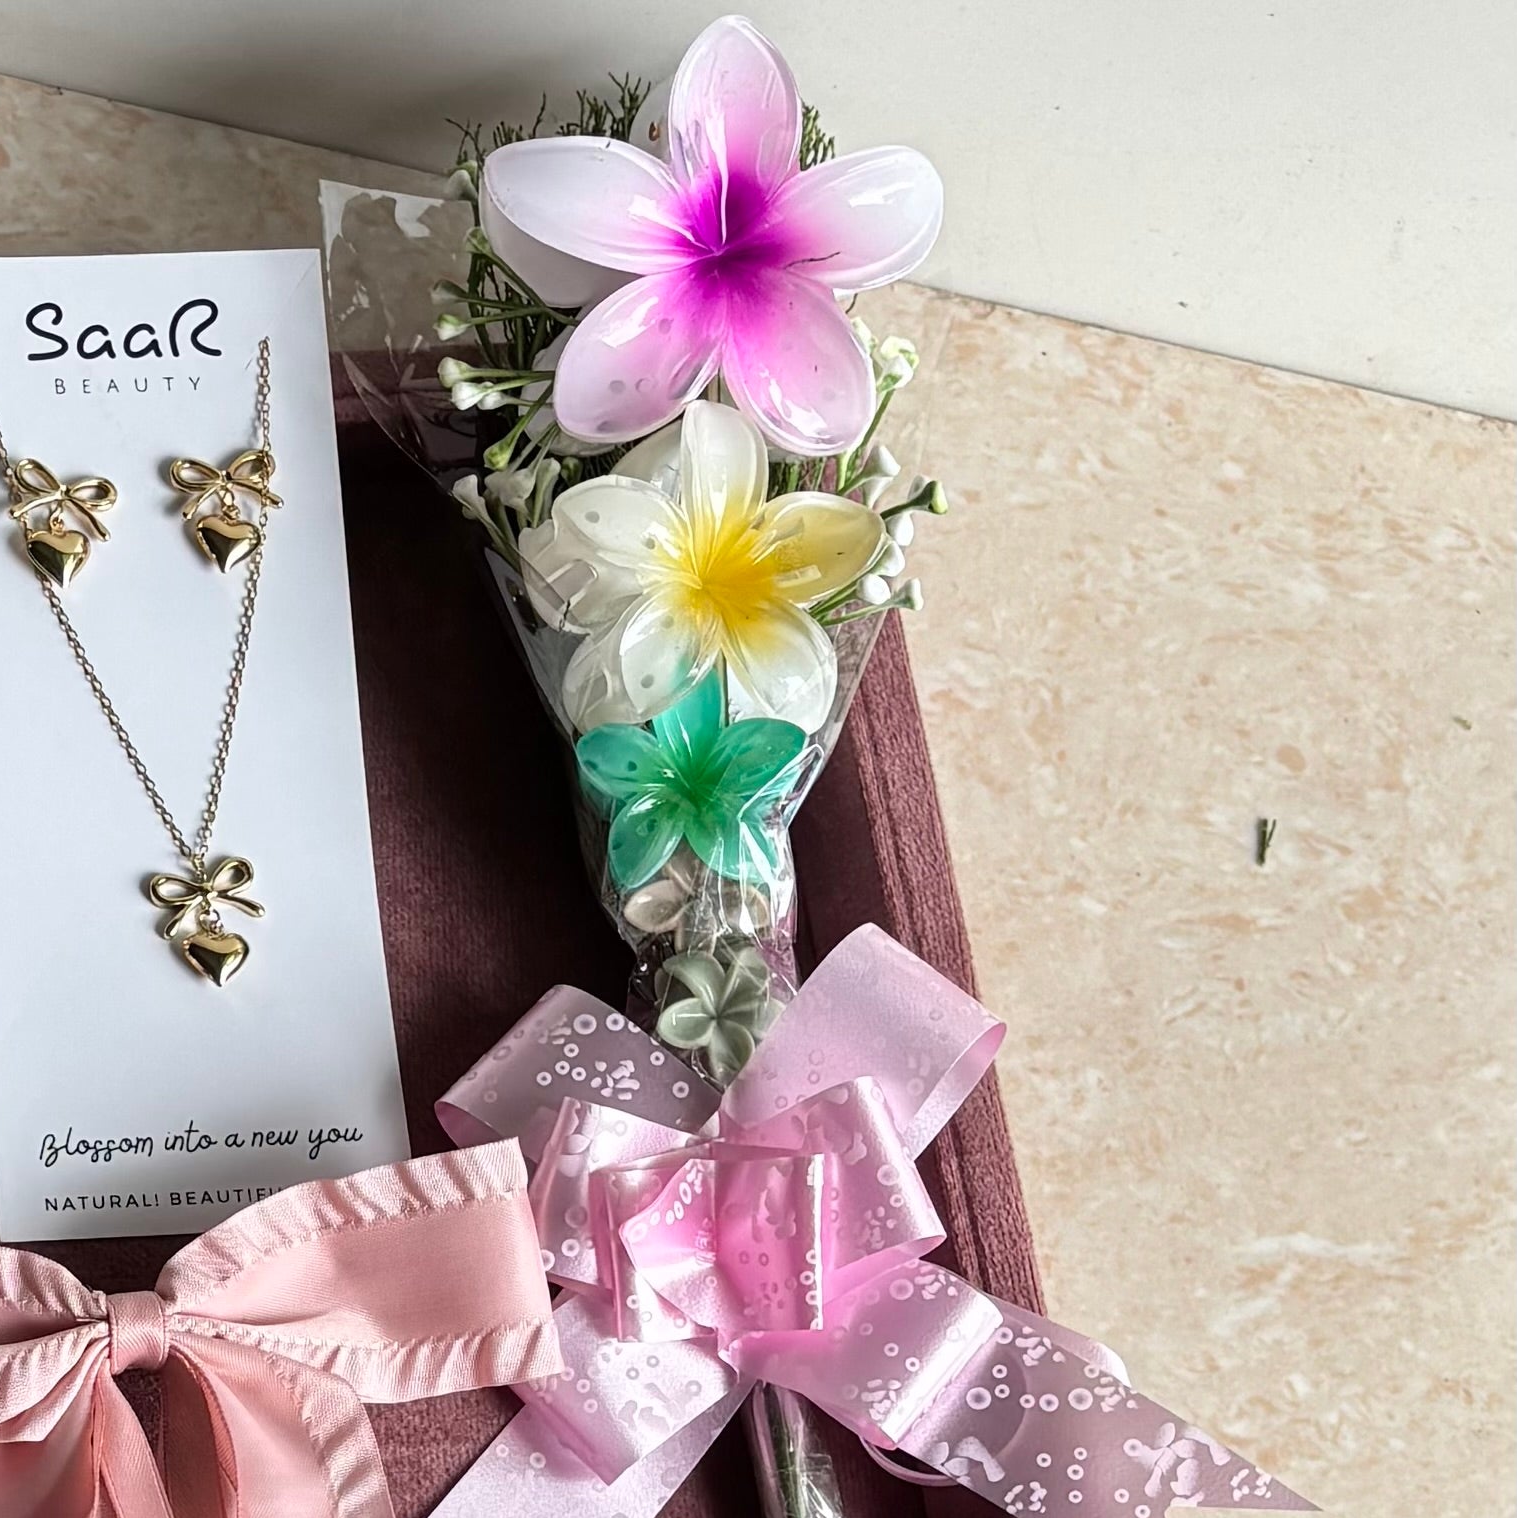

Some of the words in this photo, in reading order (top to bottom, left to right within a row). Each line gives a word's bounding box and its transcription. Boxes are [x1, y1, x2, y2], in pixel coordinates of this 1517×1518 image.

[25, 298, 223, 362] SaaR
[54, 376, 201, 395] BEAUTY
[39, 1126, 154, 1168] Blossom
[164, 1119, 218, 1153] into
[224, 1132, 245, 1148] a
[250, 1128, 298, 1148] new
[308, 1125, 364, 1161] you
[44, 1192, 160, 1213] NATURAL!
